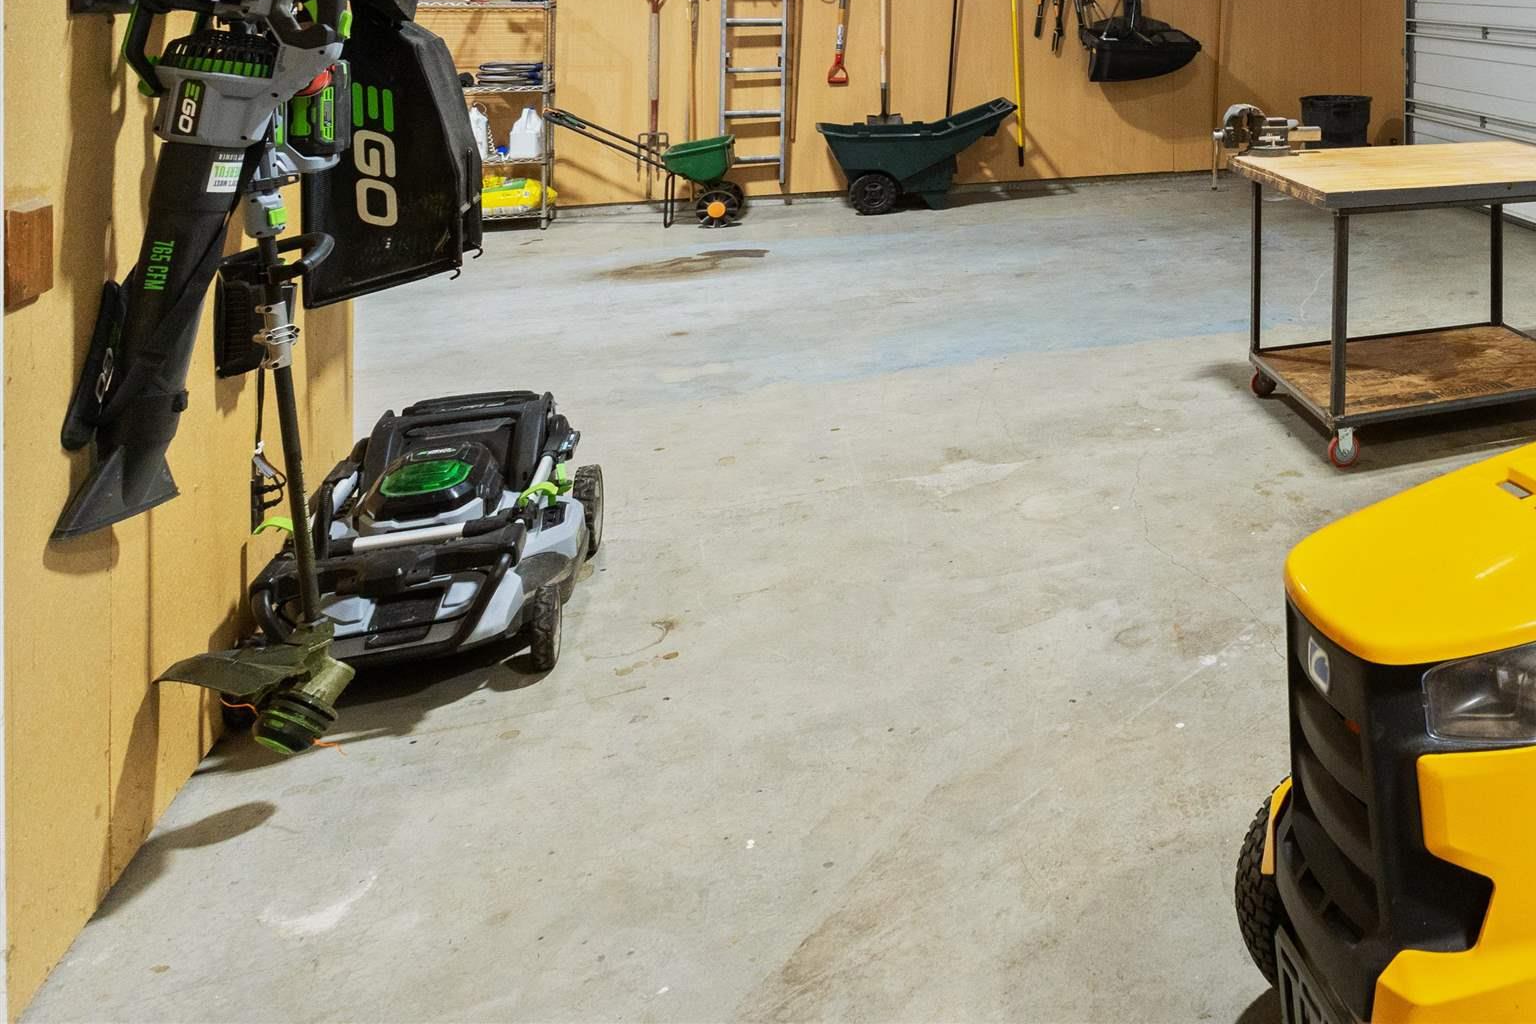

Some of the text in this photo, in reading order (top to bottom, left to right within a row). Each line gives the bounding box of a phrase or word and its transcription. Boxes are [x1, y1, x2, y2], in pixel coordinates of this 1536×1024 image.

[179, 81, 200, 133] EGO
[352, 82, 398, 226] EGO
[144, 240, 175, 290] 765 CFM
